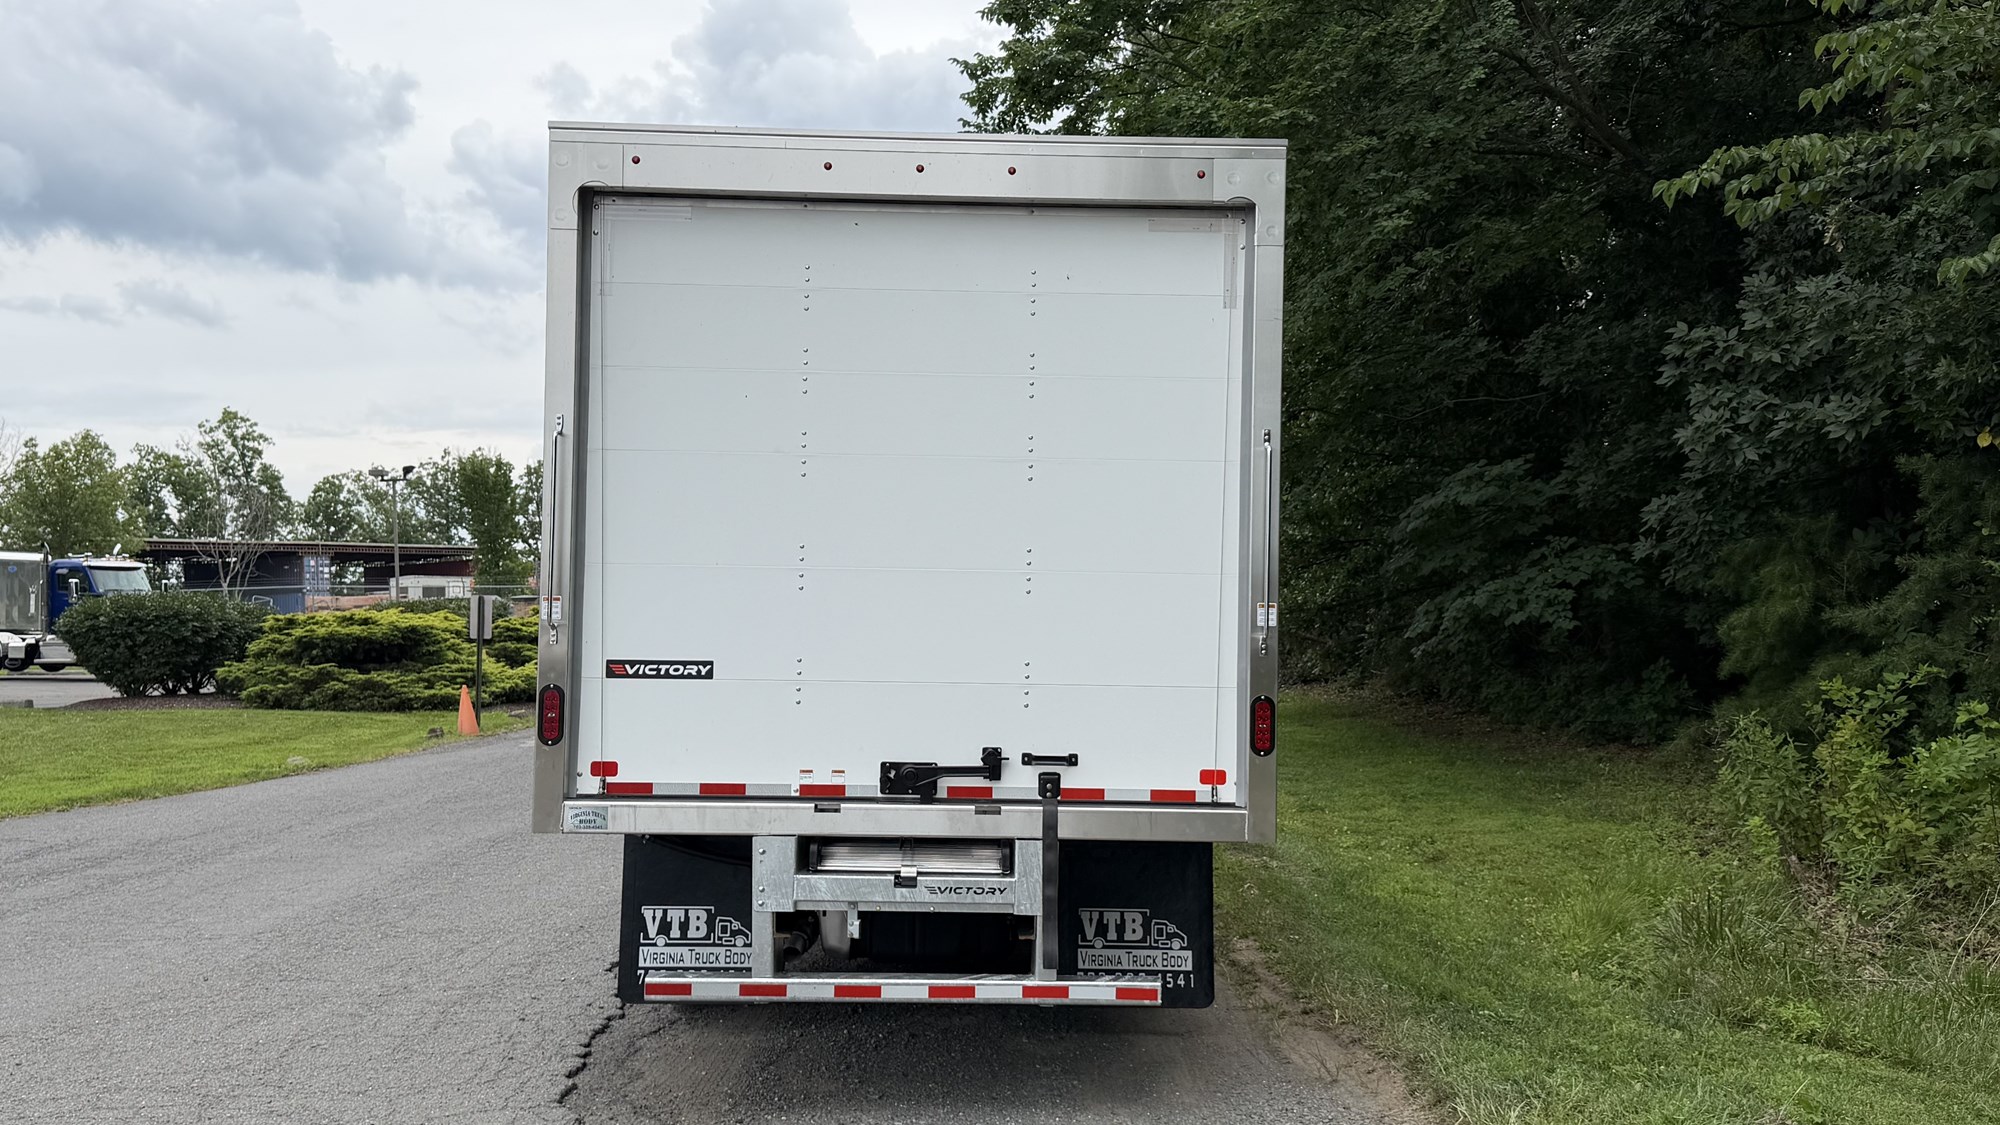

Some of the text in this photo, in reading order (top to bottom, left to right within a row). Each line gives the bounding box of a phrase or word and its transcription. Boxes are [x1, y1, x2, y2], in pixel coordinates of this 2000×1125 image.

[624, 664, 712, 676] VICTORY
[937, 886, 1008, 896] VICTORY
[643, 909, 708, 939] VTB
[1080, 911, 1144, 941] VTB
[641, 948, 752, 965] VIRGINIA TRUCK BODY
[1080, 950, 1189, 968] VIRGINIA TRUCK BODY
